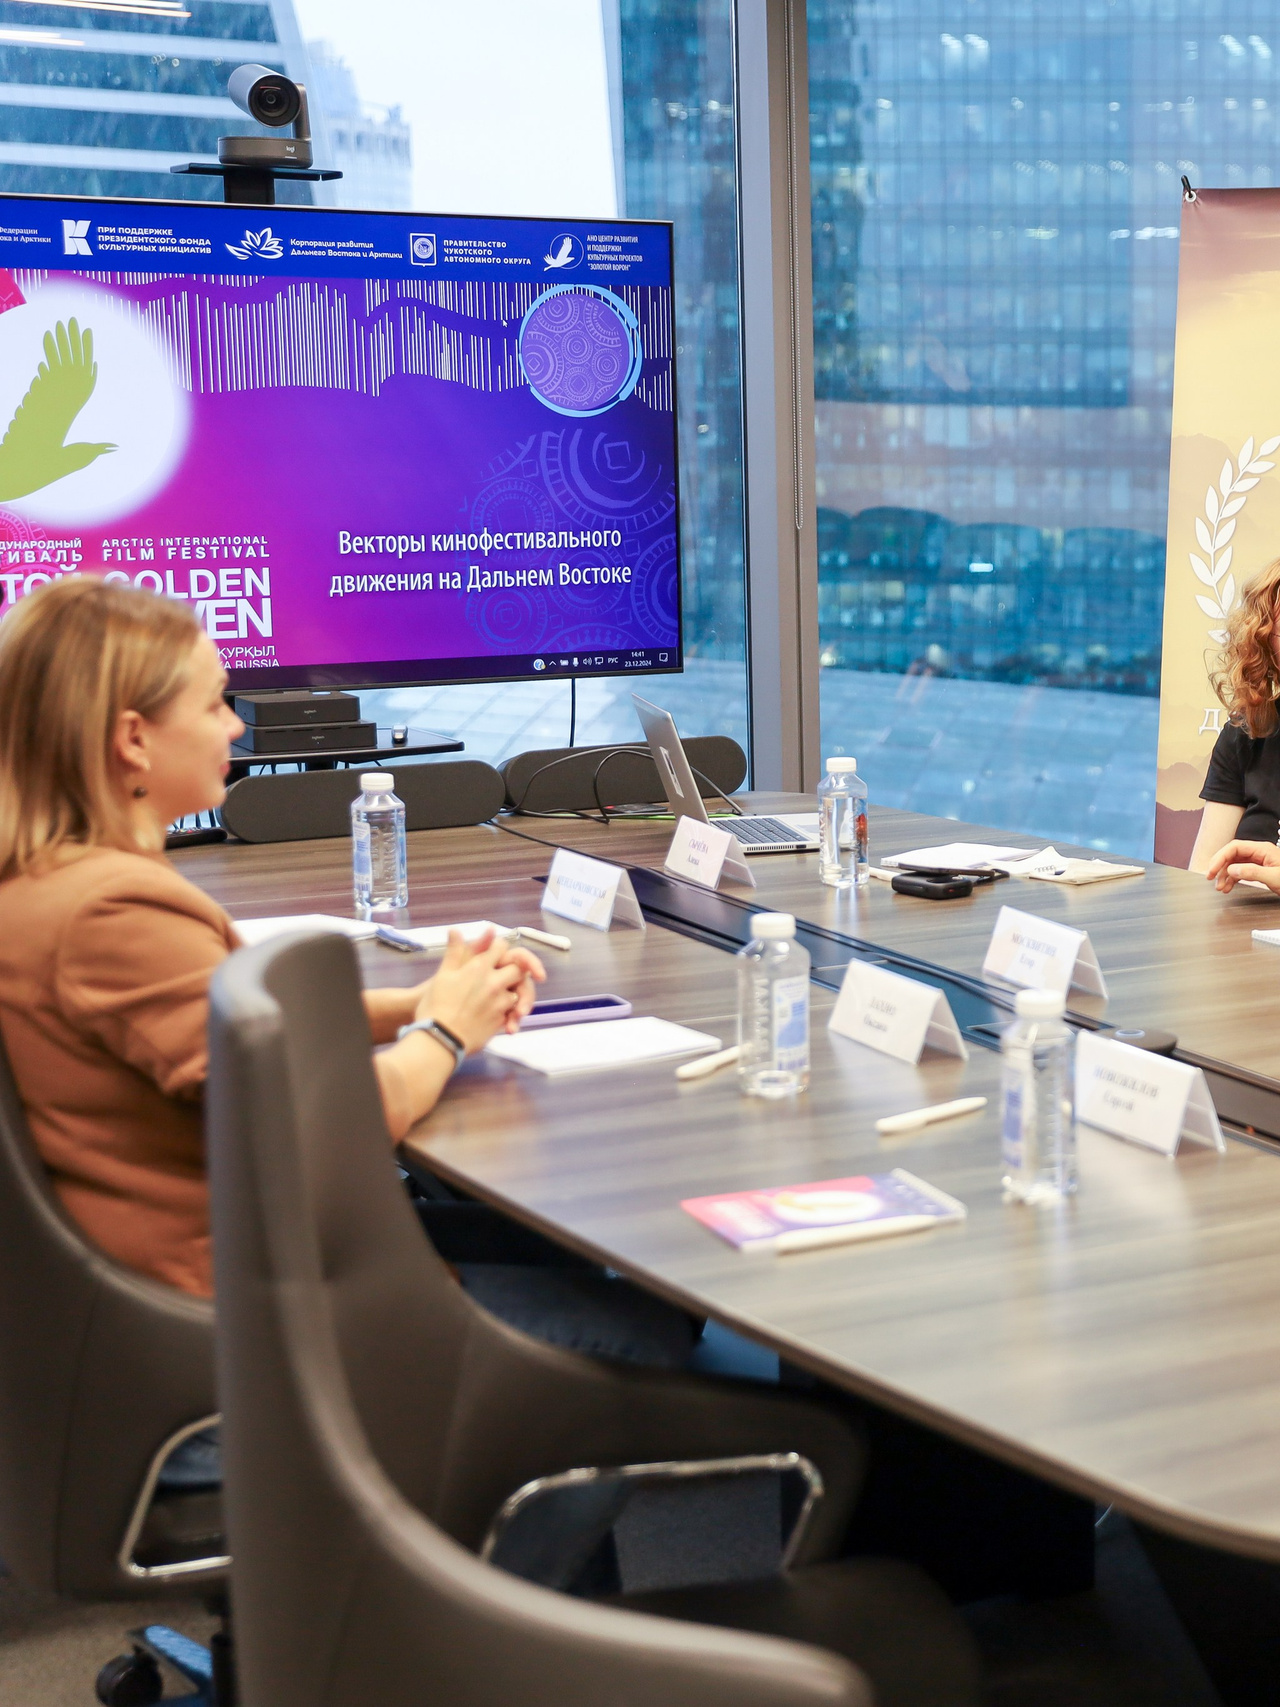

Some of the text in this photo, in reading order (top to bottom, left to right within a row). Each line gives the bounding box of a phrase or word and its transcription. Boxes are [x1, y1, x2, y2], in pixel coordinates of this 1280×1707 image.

[97, 226, 173, 236] ПРИ ПОДДЕРЖКЕ
[20, 235, 52, 243] Арктики
[98, 235, 211, 246] ПРЕЗИДЕНТСКОГО ФОНДА
[290, 238, 374, 249] Корпорация развития
[443, 239, 507, 248] ПРАВИТЕЛЬСТВО
[98, 243, 212, 254] КУЛЬТУРНЫХ ИНИЦИАТИВ
[290, 248, 326, 256] Дальнего
[327, 249, 361, 258] Востока
[368, 250, 403, 260] Арктики
[443, 248, 493, 256] ЧУКОТСКОГО
[444, 256, 531, 265] АВТОНОМНОГО ОКРУГА
[102, 536, 268, 548] ARCTIC INTERNATIONAL
[339, 527, 622, 559] Векторы кинофестивального
[103, 545, 270, 562] FILM FESTIVAL
[329, 562, 632, 597] движения на Дальнем Востоке
[624, 660, 652, 668] 23.12.2024
